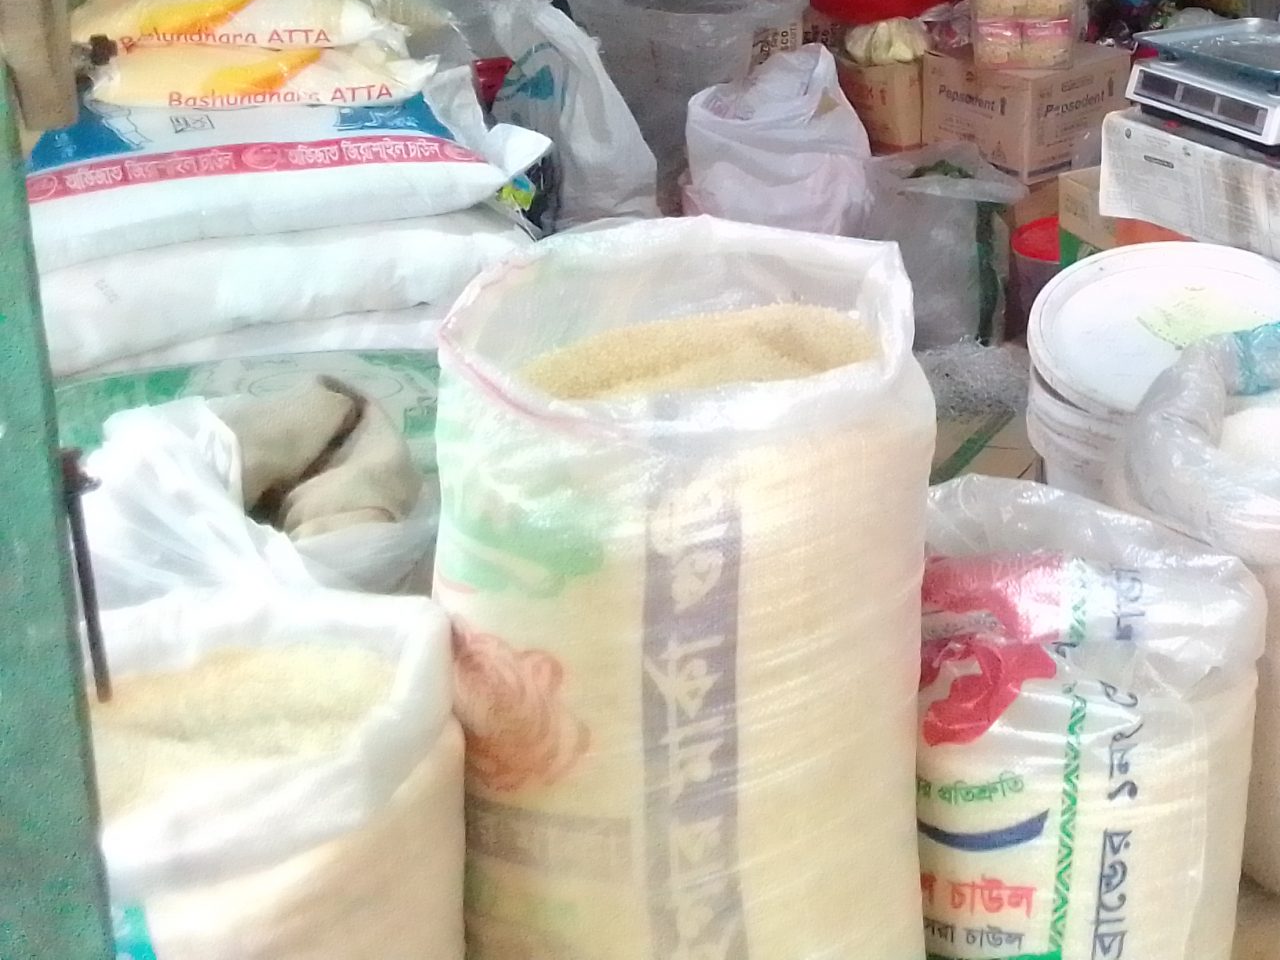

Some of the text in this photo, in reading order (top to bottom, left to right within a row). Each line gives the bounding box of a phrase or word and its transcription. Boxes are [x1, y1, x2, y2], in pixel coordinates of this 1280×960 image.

[267, 29, 332, 45] ATTA
[331, 84, 393, 104] ATTA
[938, 85, 997, 113] Pepsodent
[950, 873, 1037, 919] চাউল
[966, 924, 1025, 951] চাউল
